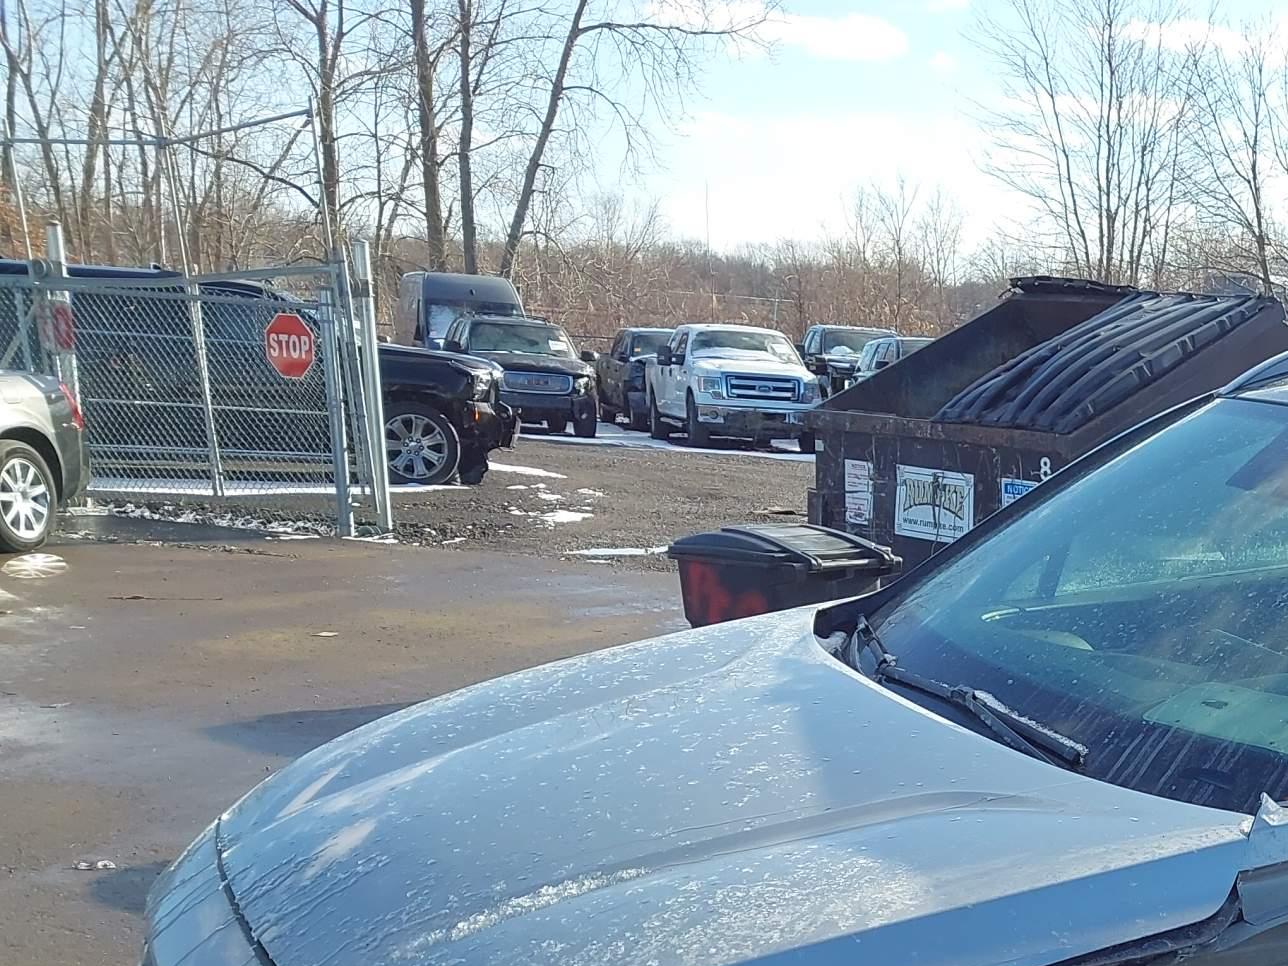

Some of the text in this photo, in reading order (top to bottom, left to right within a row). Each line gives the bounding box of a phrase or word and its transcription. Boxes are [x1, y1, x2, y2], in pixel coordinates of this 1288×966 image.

[270, 333, 310, 359] STOP
[1040, 456, 1051, 480] 8
[903, 478, 965, 521] RUMKE
[1007, 484, 1032, 495] NOTIC
[902, 516, 964, 533] www.rume.com
